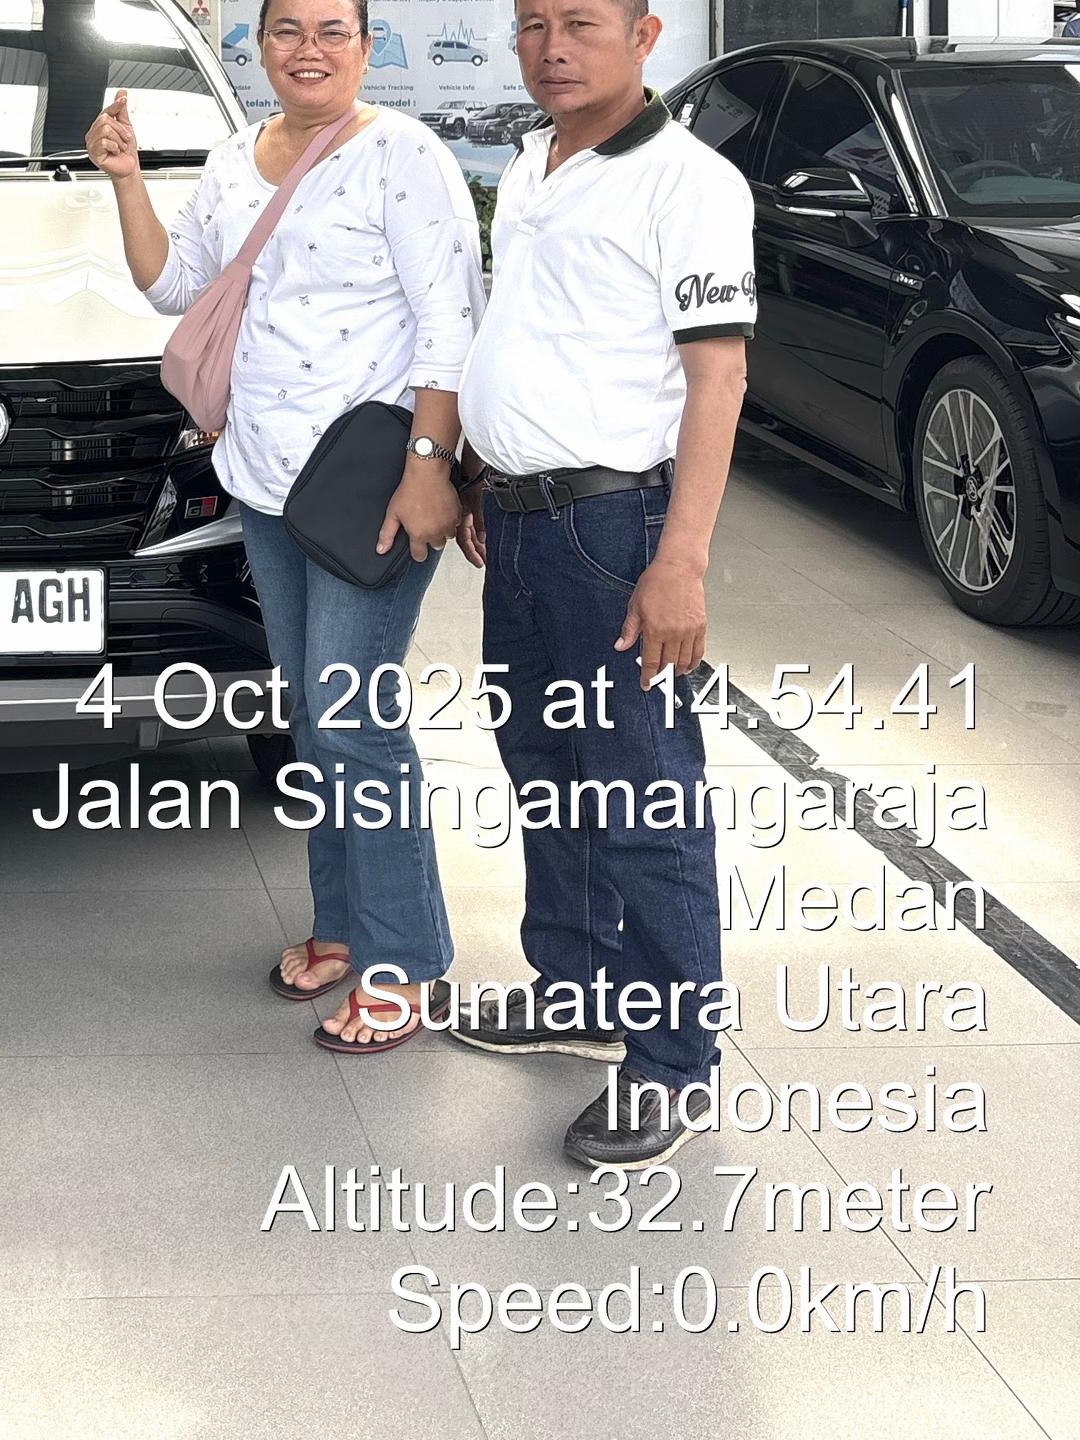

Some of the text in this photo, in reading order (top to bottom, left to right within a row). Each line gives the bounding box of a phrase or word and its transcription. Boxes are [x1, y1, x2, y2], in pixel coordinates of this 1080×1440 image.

[246, 99, 271, 108] telah
[379, 99, 411, 107] model
[675, 272, 740, 312] New
[11, 577, 91, 623] AGH
